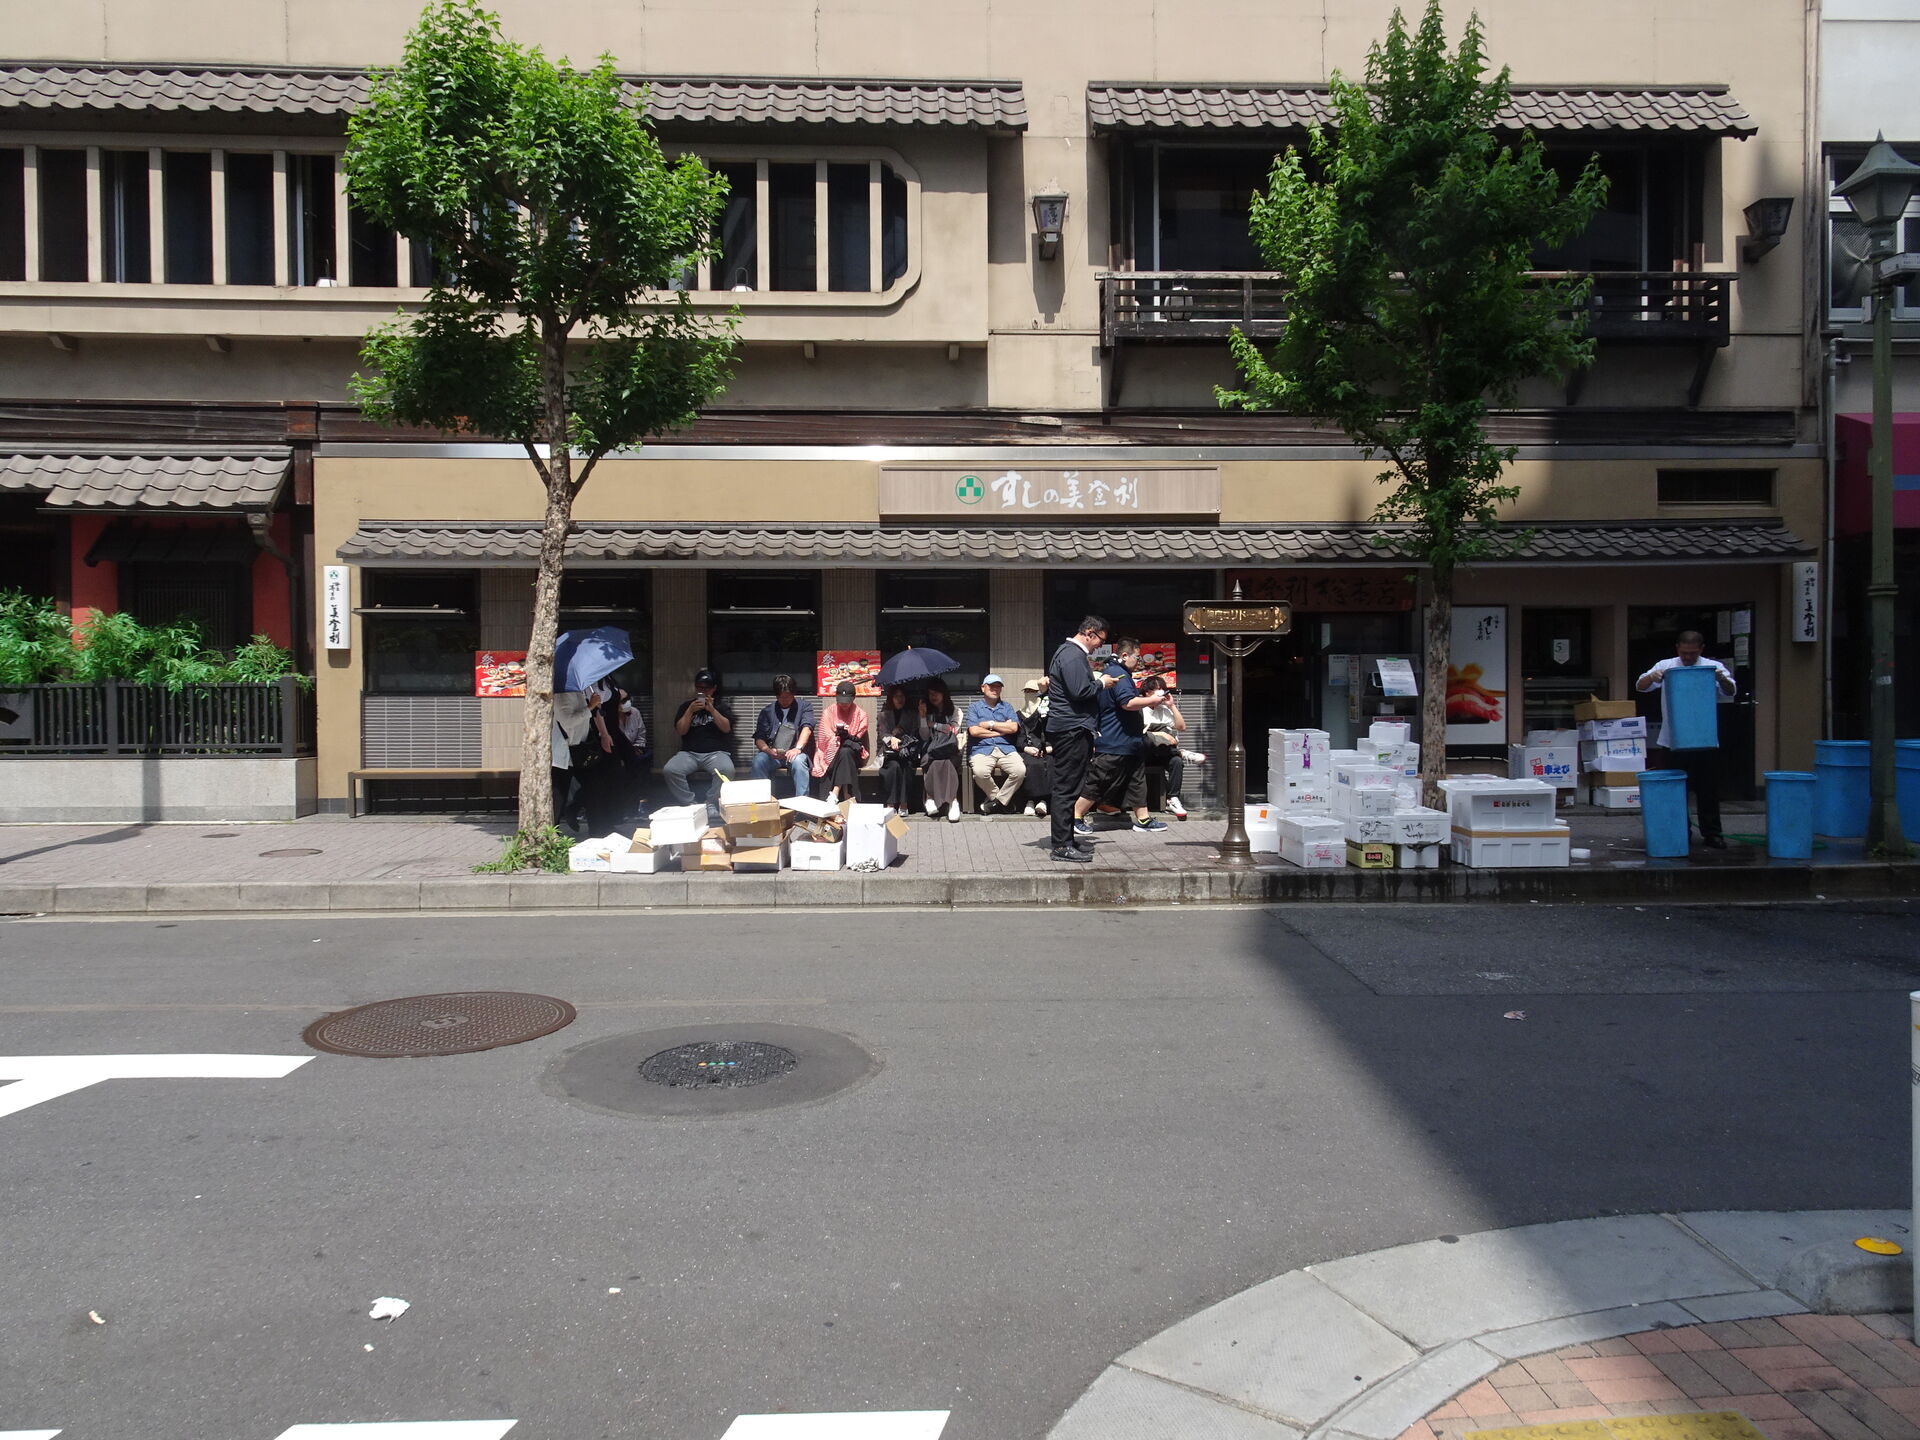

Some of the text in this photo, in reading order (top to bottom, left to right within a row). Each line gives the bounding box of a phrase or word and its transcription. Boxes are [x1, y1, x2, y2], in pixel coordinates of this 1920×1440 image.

[991, 470, 1138, 508] すしの美登利
